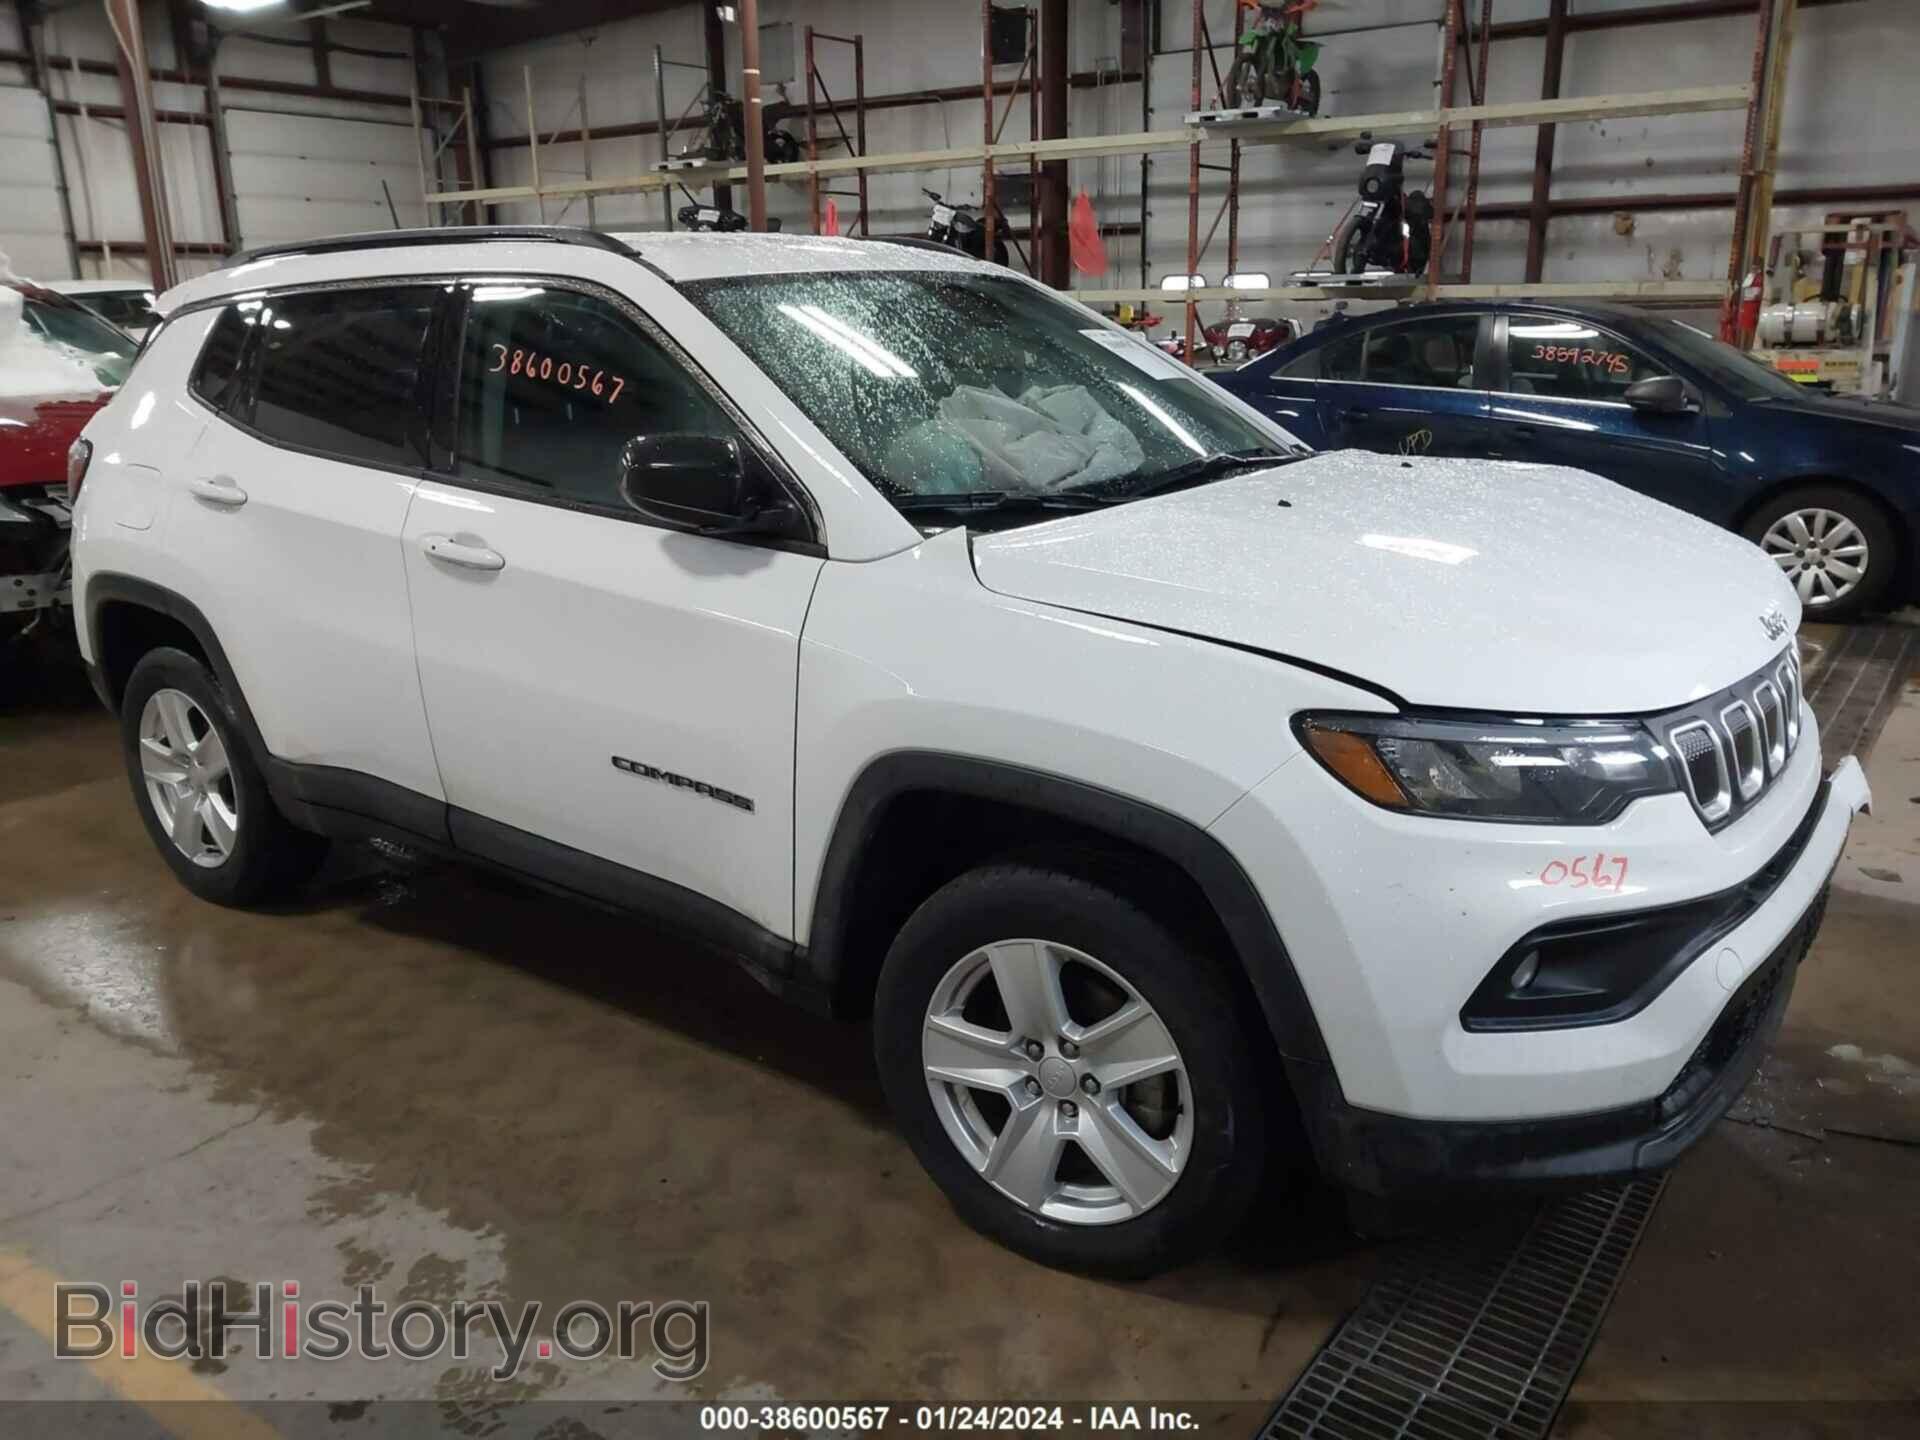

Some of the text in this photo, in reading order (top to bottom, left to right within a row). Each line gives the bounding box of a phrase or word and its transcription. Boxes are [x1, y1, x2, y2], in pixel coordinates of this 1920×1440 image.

[489, 343, 625, 404] 38600567
[1531, 345, 1629, 373] 38592745
[611, 755, 755, 813] COMPASS
[1540, 853, 1628, 891] 0567
